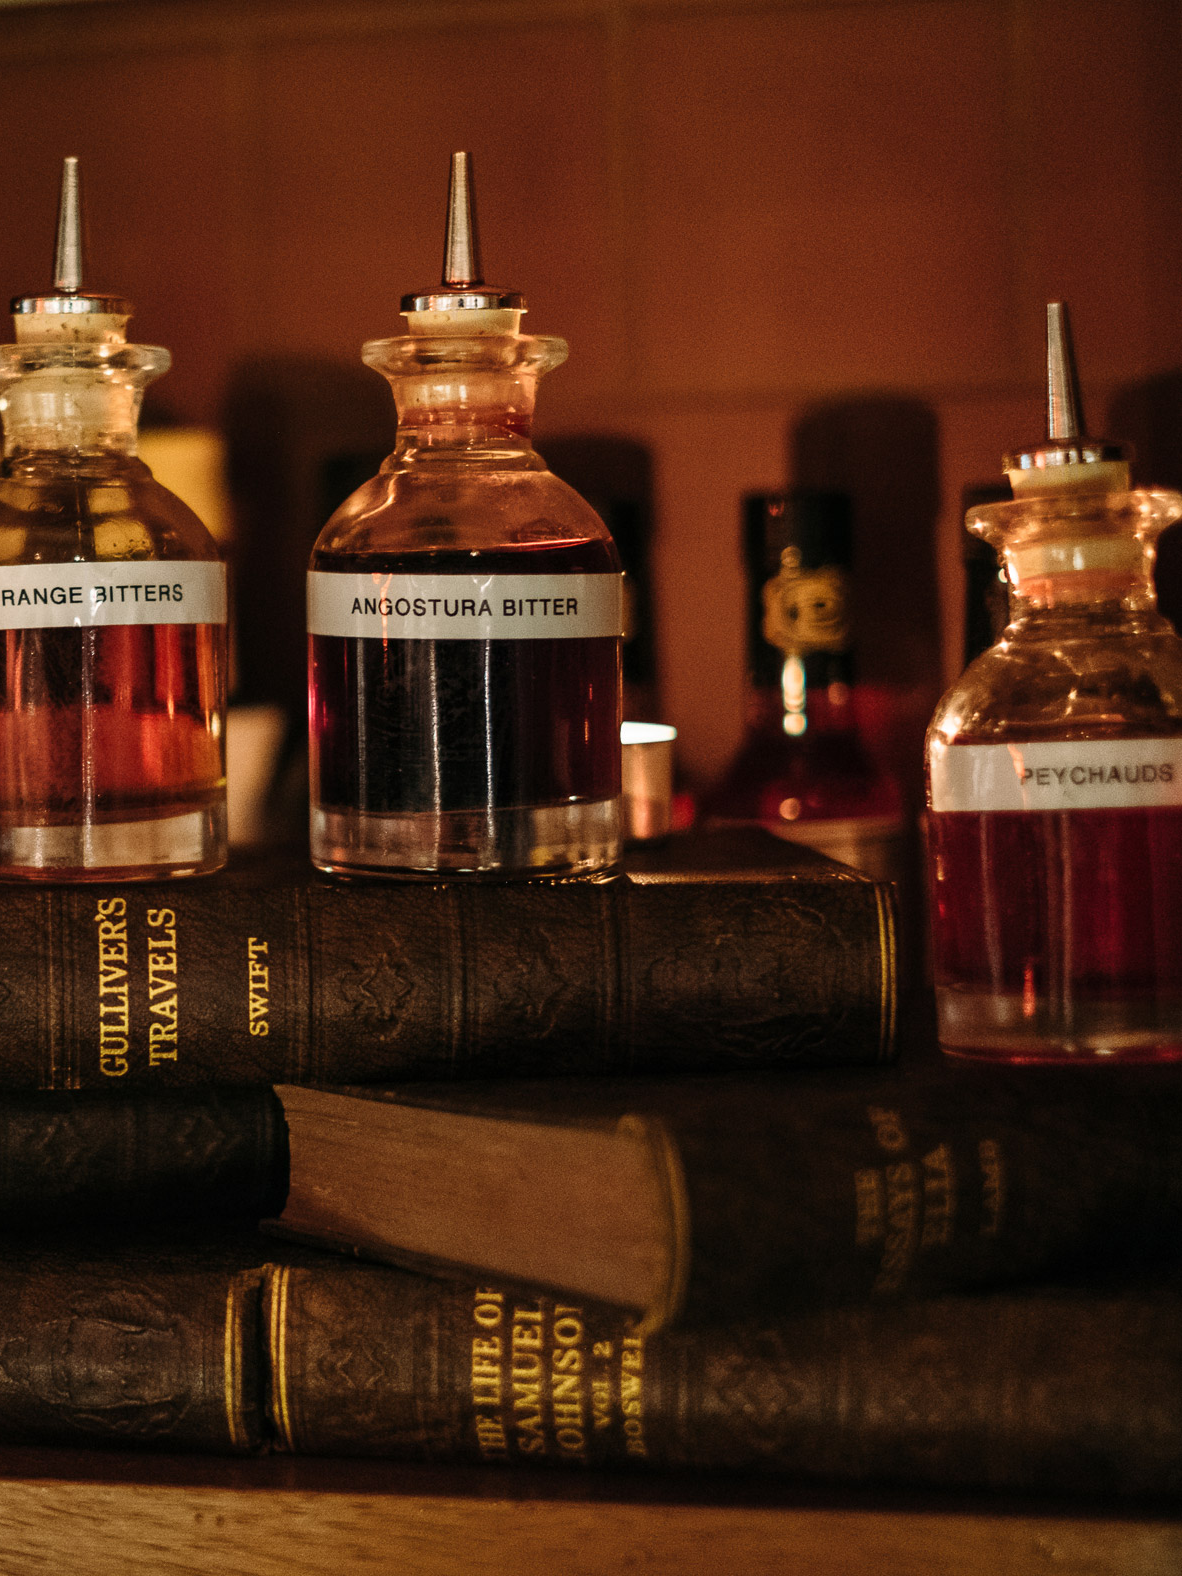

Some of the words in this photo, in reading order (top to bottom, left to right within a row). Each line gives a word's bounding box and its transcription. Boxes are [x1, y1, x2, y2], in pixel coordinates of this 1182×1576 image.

[93, 583, 184, 603] BITTERS
[351, 597, 493, 617] ANGOSTURA
[502, 597, 579, 616] BITTER
[1020, 763, 1174, 786] PEYCHAUDS
[94, 897, 129, 1077] GULLIVER'S
[147, 908, 178, 1067] TRAVELS
[247, 937, 269, 1037] SWIFT
[472, 1336, 502, 1405] LIFE
[512, 1297, 547, 1454] SAMUEL
[620, 1334, 648, 1456] BOSWEL
